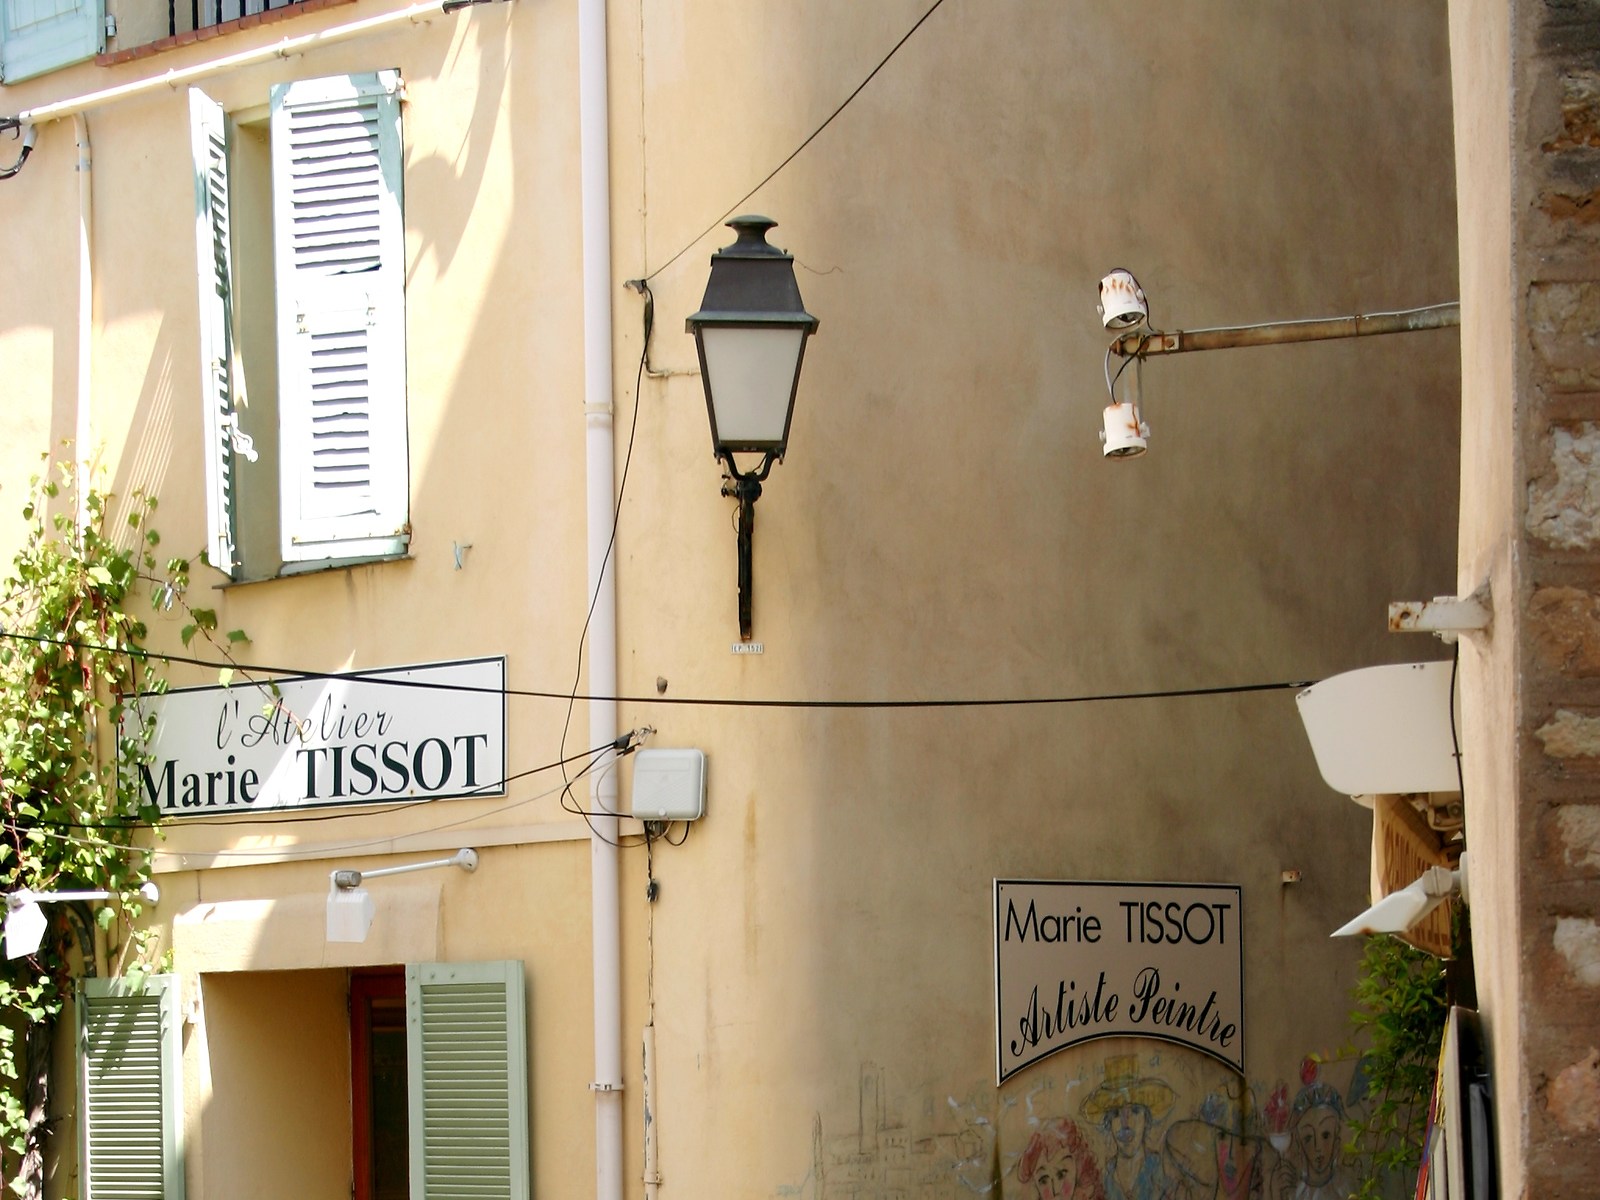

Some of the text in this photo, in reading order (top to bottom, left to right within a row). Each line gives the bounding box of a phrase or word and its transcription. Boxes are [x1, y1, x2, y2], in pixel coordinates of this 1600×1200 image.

[217, 693, 393, 750] l'Atelier
[136, 734, 488, 809] Marie TISSOT
[1004, 899, 1231, 944] Marie TISSOT
[1011, 967, 1236, 1057] Artiste Peintre
